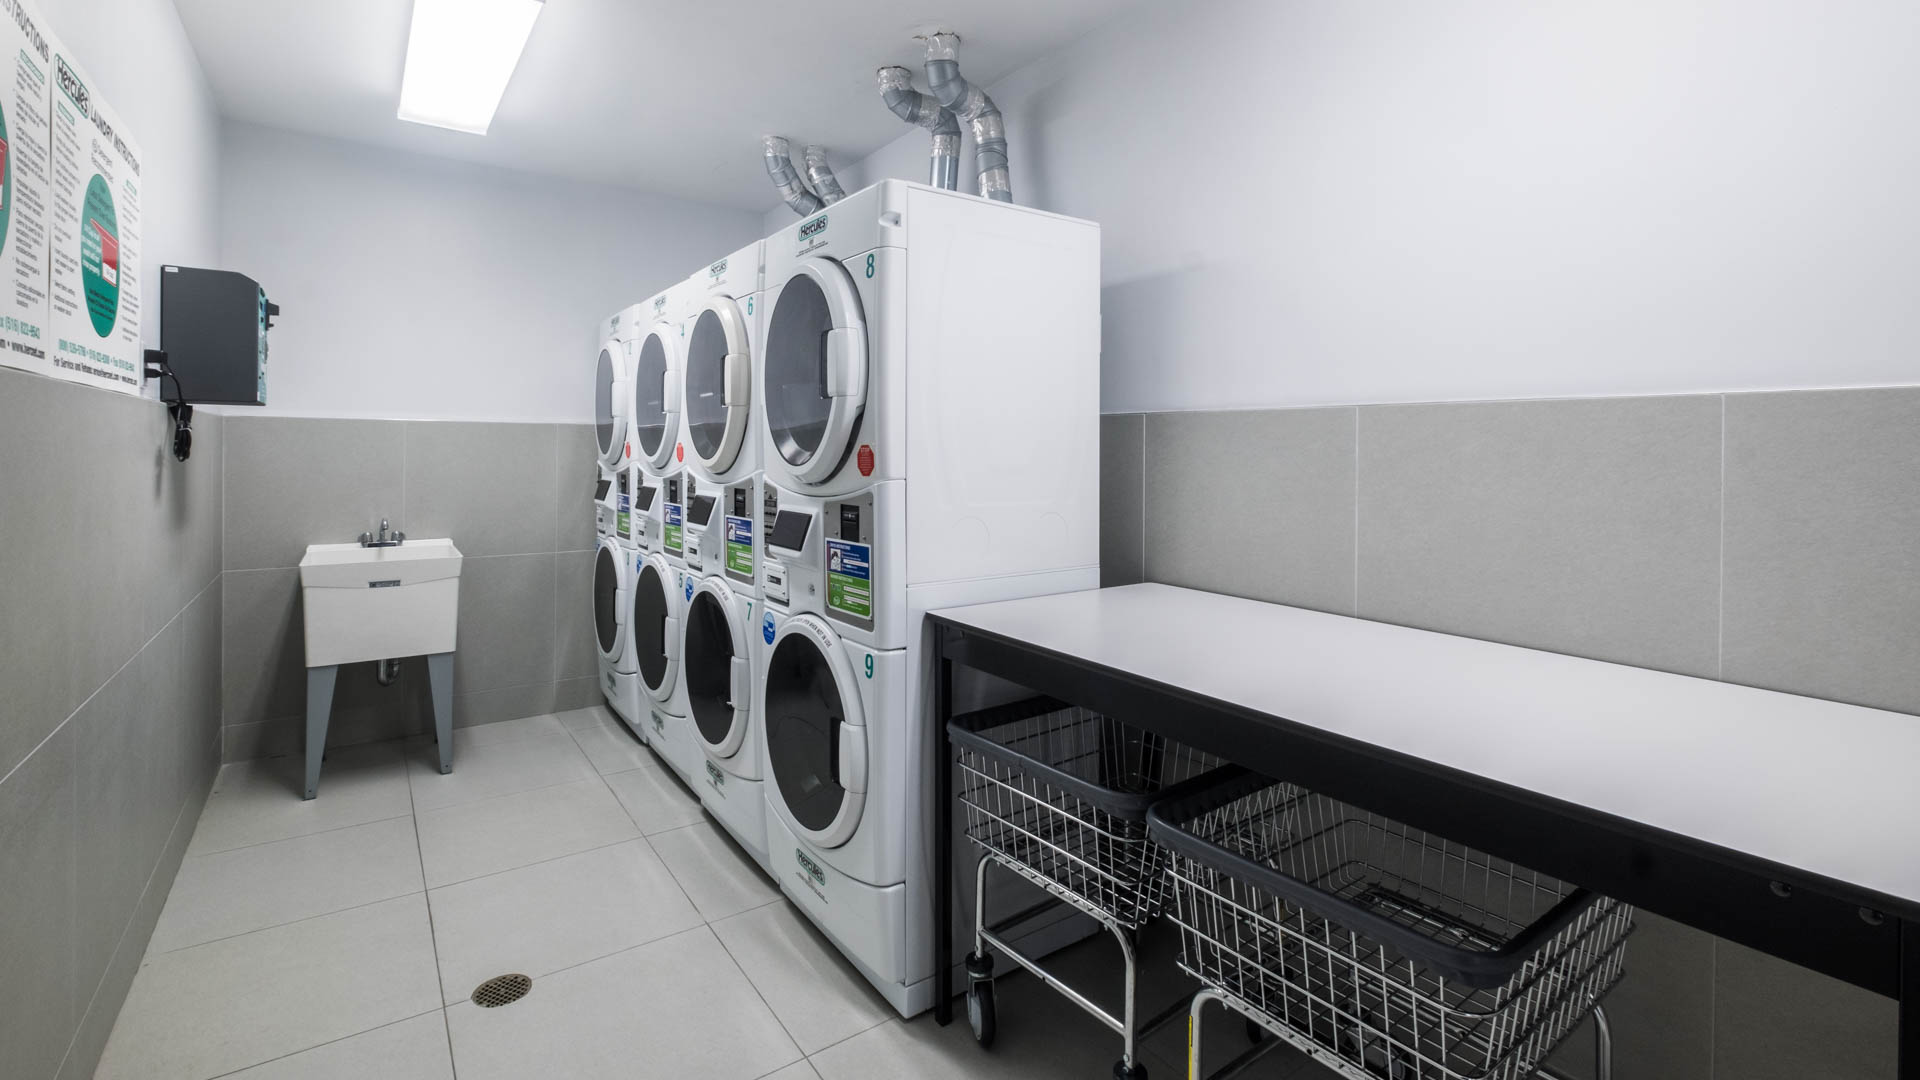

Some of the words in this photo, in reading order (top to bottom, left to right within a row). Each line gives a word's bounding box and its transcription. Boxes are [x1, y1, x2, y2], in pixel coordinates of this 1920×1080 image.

[57, 57, 88, 114] Hercules
[91, 104, 114, 144] LAUNDRY
[113, 133, 140, 176] INSTRUCTIONS
[800, 217, 827, 239] Hercules
[866, 253, 875, 279] 8
[747, 296, 754, 316] 6
[746, 601, 753, 622] 7
[824, 639, 833, 649] USE
[865, 653, 874, 680] 9
[797, 849, 825, 884] Hercules
